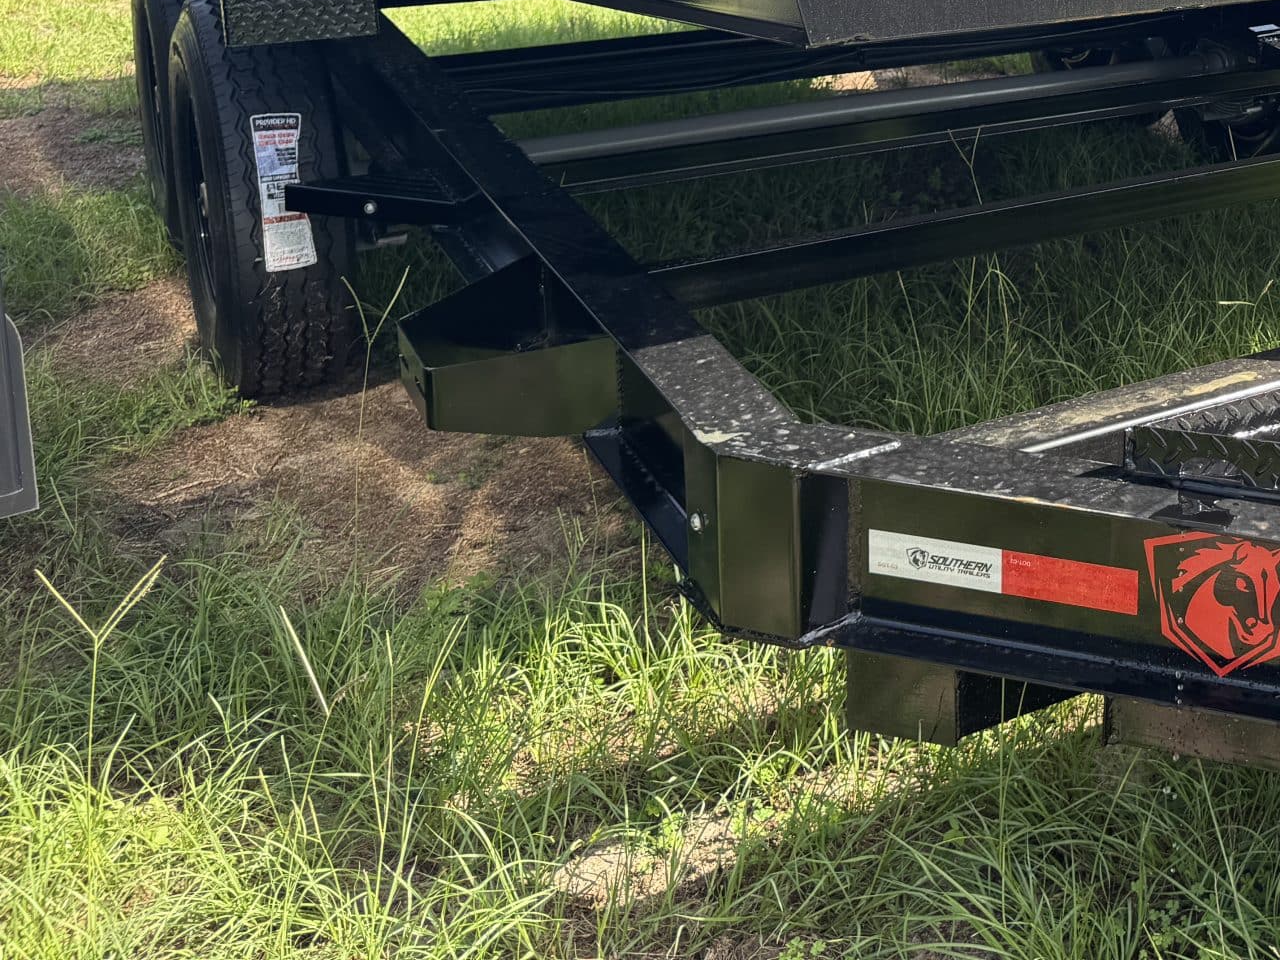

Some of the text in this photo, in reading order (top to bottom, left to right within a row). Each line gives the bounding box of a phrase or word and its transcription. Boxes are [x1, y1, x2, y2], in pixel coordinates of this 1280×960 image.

[928, 555, 993, 573] SOUTHERN
[928, 564, 991, 579] UTILITY TRAILERS
